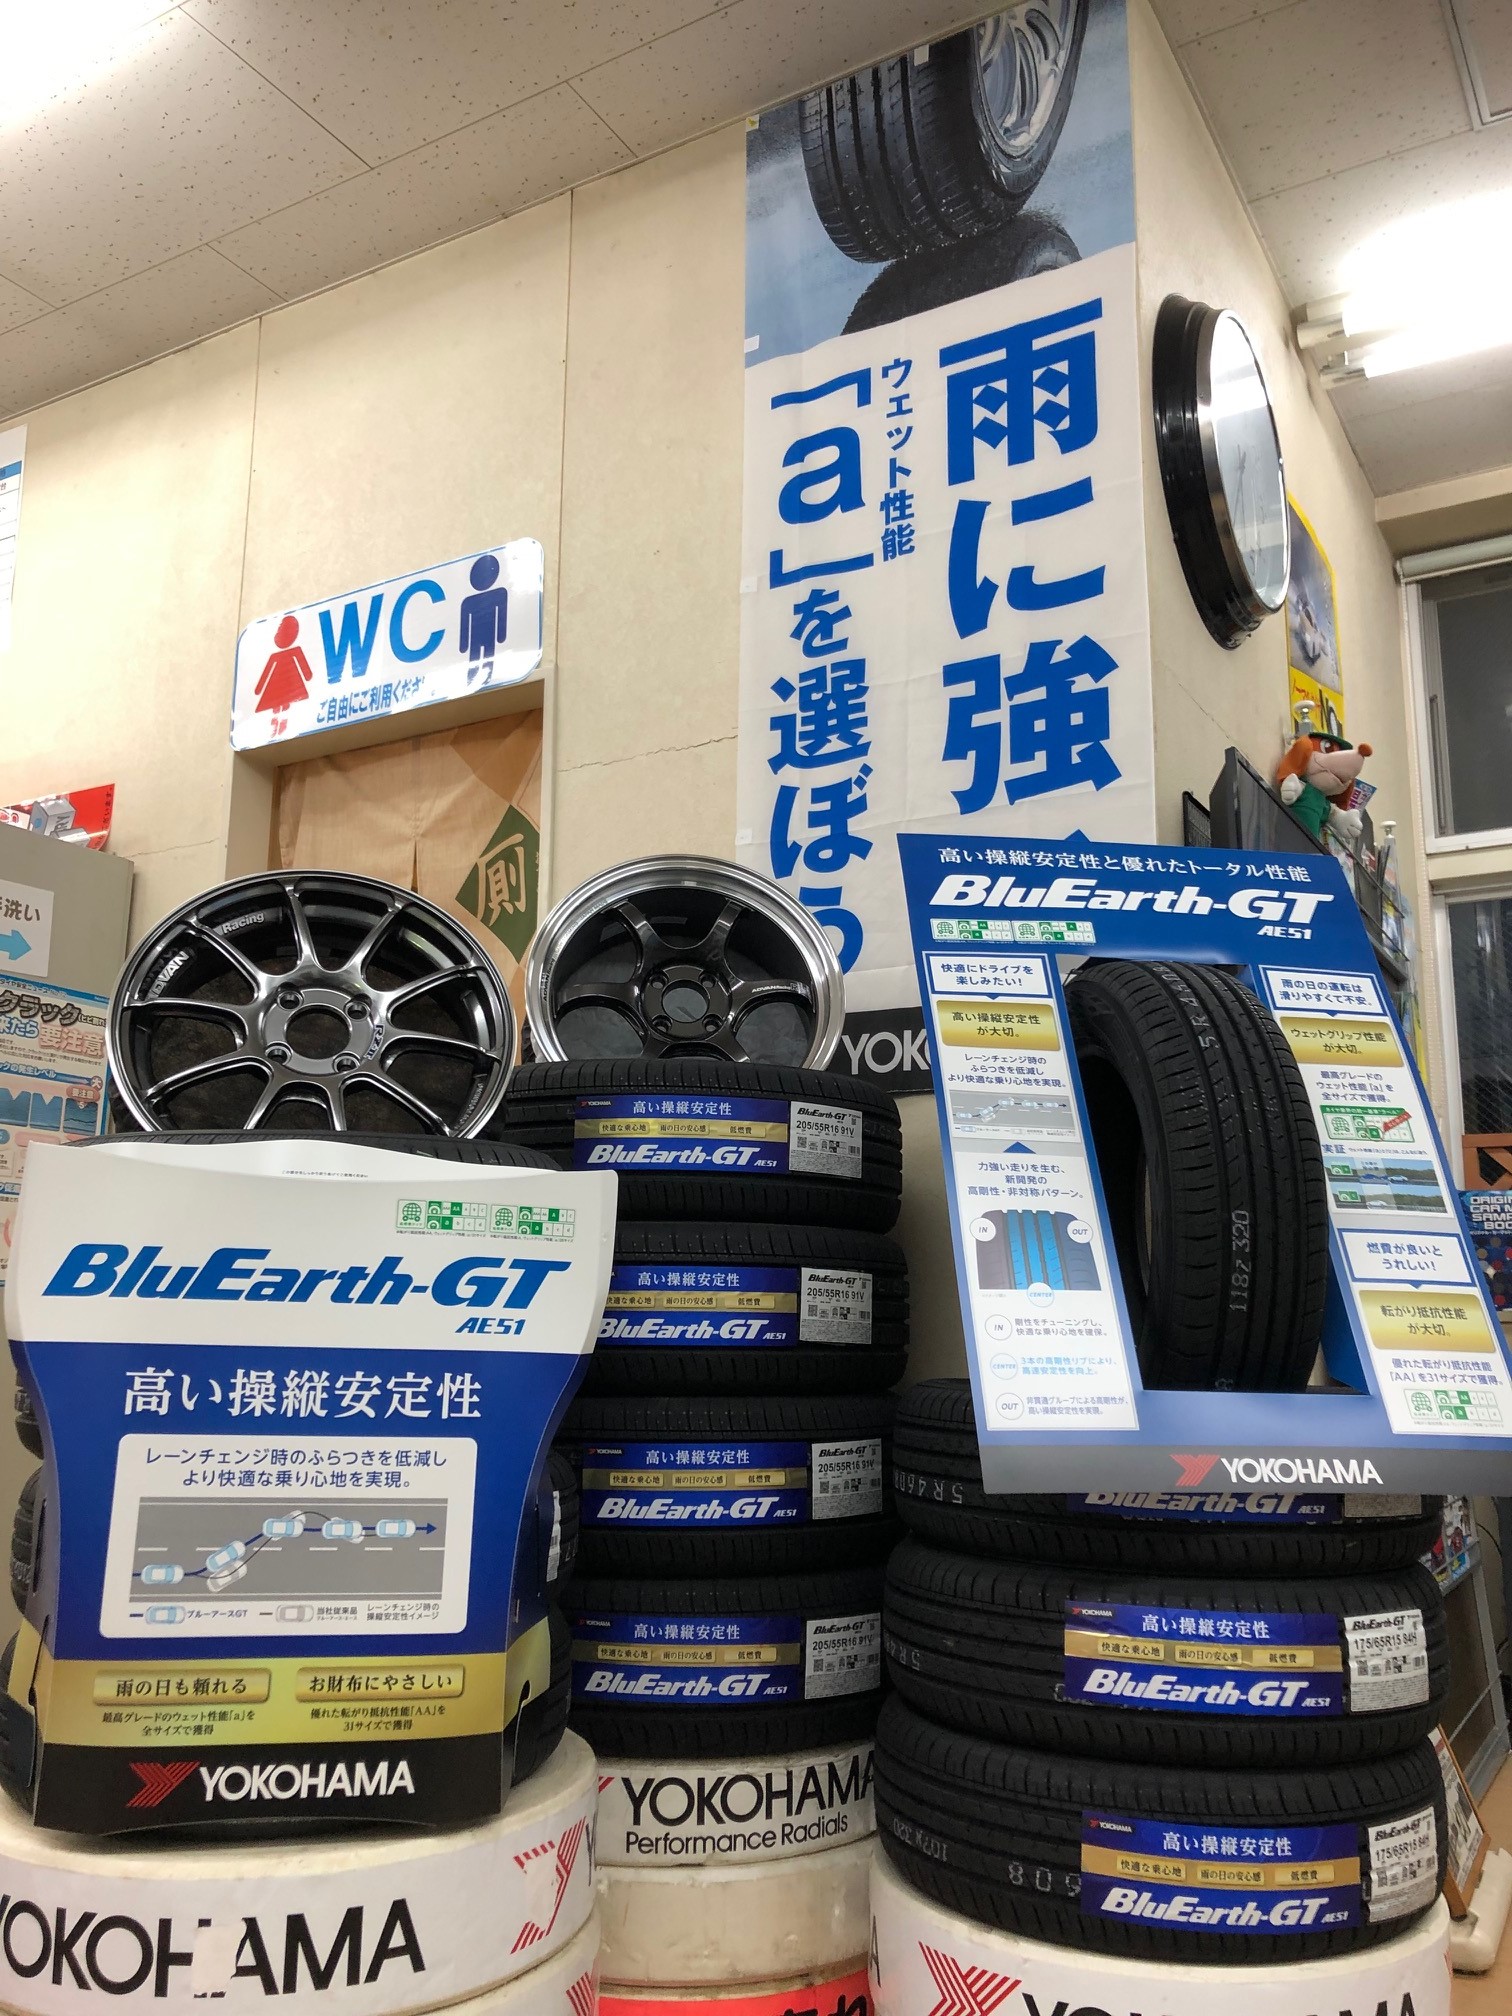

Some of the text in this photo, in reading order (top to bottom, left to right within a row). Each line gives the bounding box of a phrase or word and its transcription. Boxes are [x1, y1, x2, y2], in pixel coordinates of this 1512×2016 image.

[880, 357, 915, 562] ウェット性能
[938, 297, 1124, 842] 雨に強
[319, 579, 446, 685] WC
[938, 847, 1312, 883] 高い操縦安定性と優れたトータル性能
[929, 874, 1334, 924] BluEarth-GT
[0, 895, 41, 922] 洗い
[222, 912, 265, 934] Racing
[1257, 926, 1312, 940] AE51
[941, 963, 1034, 975] 快適にドライブを
[1281, 978, 1363, 993] 雨の日の運転は
[1279, 990, 1372, 1006] 滑りやすくて不安。
[952, 1011, 1041, 1025] 高い操縦安定性
[977, 1026, 1020, 1038] が大切。
[1291, 1028, 1387, 1042] ウェットグリップ性能
[39, 1023, 105, 1059] 要注意
[1323, 1043, 1363, 1055] が大切。
[841, 1028, 931, 1076] YOK
[964, 1053, 1047, 1065] レーンチェンジ時の
[0, 1060, 57, 1079] クの発生レベル
[970, 1064, 1044, 1076] ふらつきを低減し
[1320, 1070, 1383, 1080] 最高グレードの
[948, 1074, 1067, 1088] より快適な乗り心地を実現。
[633, 1100, 732, 1116] 高い操縦安定性
[602, 1124, 646, 1132] 快適な乗心地
[660, 1125, 706, 1133] 雨の日の安心感
[796, 1120, 855, 1136] 205/55R16 91V
[586, 1144, 761, 1166] BluEarth-GT
[978, 1162, 1066, 1174] 力強い走りを生む、
[1005, 1174, 1047, 1185] 新開発の
[1470, 1196, 1512, 1204] ORIGI
[1470, 1204, 1500, 1213] CAR
[978, 1226, 988, 1234] IN
[1072, 1228, 1088, 1236] OUT
[1367, 1241, 1443, 1257] 燃費が良いと
[42, 1243, 571, 1310] BluEarth-GT
[638, 1272, 740, 1287] 高い操縦安定性
[607, 1296, 652, 1304] 快適な乗心地
[666, 1297, 713, 1306] 雨の日の安心感
[807, 1287, 865, 1300] 205/55R16 91V
[1381, 1304, 1468, 1321] 転がり抵抗性能
[454, 1318, 526, 1335] AE51
[597, 1318, 769, 1340] BluEarth-GT
[763, 1332, 787, 1340] AE51
[1014, 1318, 1103, 1327] 剛性をチューニングし、
[1409, 1322, 1451, 1337] が大切。
[1391, 1358, 1493, 1372] 優れた転がり抵抗性能
[123, 1367, 481, 1419] 高い操縦安定性
[1001, 1403, 1018, 1411] OUT
[146, 1448, 447, 1467] レーンチェンジ時のふらつきを低減し
[646, 1449, 750, 1465] 高い操縦安定性
[818, 1458, 875, 1473] 205/55R16 91V
[1221, 1457, 1384, 1485] YOKOHAMA
[182, 1470, 411, 1488] より快適な乗り心地を実現。
[613, 1475, 660, 1484] 快適な乗心地
[675, 1475, 723, 1485] 雨の日の安心感
[597, 1496, 797, 1520] BluEarth-GT AE51
[187, 1609, 248, 1619] ブルーアースGT
[316, 1606, 357, 1616] 当社従来品
[367, 1602, 440, 1612] レーンチェンジ時の
[366, 1611, 440, 1621] 操縦安定性イメージ
[634, 1623, 740, 1640] 高い操縦安定性
[1142, 1614, 1270, 1639] 高い操縦安定性
[812, 1634, 873, 1651] 205/55R16 91V
[1354, 1634, 1400, 1649] 175/65R15
[600, 1649, 648, 1659] 快適な乗心地
[663, 1651, 712, 1661] 雨の日の安心感
[1102, 1642, 1160, 1658] 快適な乗心地
[1179, 1649, 1239, 1663] 雨の日の安心感
[116, 1677, 248, 1697] 雨の日も頼れる
[309, 1674, 452, 1694] お財布にやさしい
[585, 1670, 787, 1696] BluEarth-GT AE51
[1083, 1668, 1331, 1707] BluEarth-GT AE51
[102, 1710, 255, 1724] 最高グレードのウェット性能「a」を
[310, 1705, 447, 1719] 優れた転がり抵抗性能「AA」を
[141, 1723, 214, 1737] 全サイズで獲得
[343, 1719, 413, 1733] 31サイズで獲得
[200, 1760, 415, 1802] YOKOHAMA
[626, 1829, 777, 1855] Performance
[781, 1812, 849, 1846] Radials
[1163, 1832, 1292, 1856] 高い操縦安定性
[1120, 1860, 1182, 1877] 快適な乗心地
[1200, 1869, 1262, 1882] 雨の日の安心感
[1101, 1887, 1349, 1926] BluEarth-GT AE51
